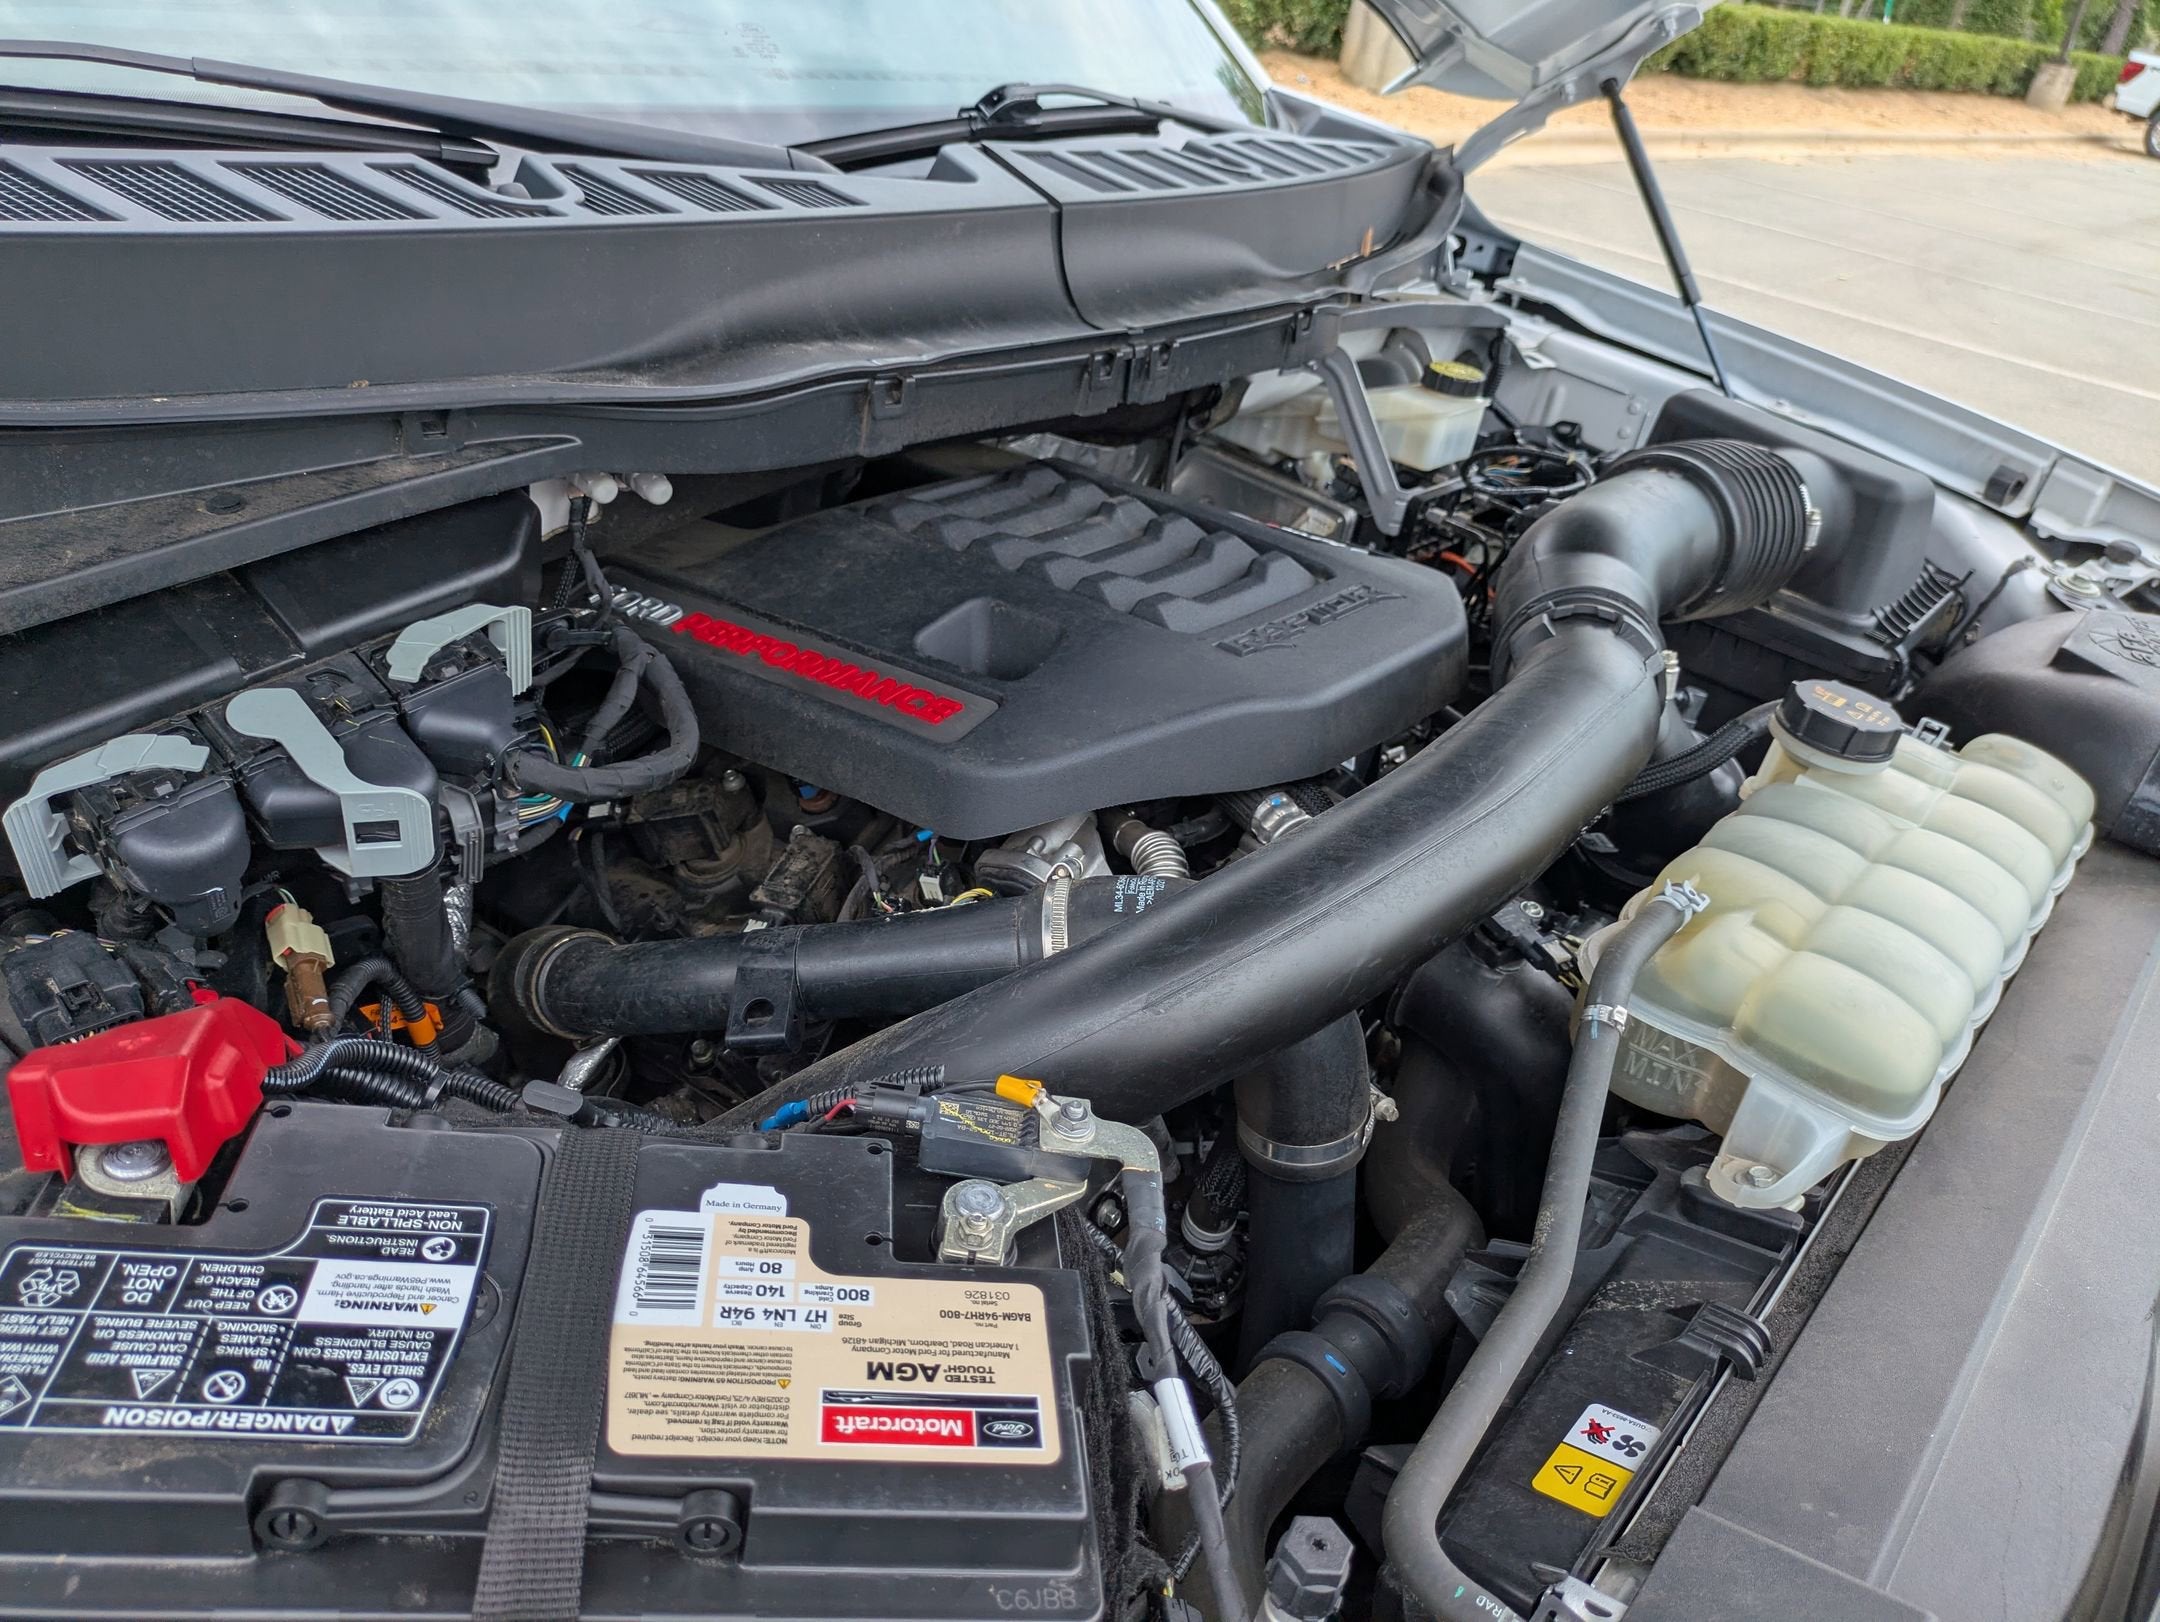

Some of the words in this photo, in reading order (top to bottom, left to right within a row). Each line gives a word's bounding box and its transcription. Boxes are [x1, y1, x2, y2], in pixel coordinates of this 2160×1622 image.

[1212, 583, 1406, 657] RAPTOR
[672, 611, 964, 726] PERFORMANCE
[1635, 1024, 1701, 1067] MAX
[1624, 1051, 1692, 1095] MIN
[349, 1205, 394, 1216] Battery
[743, 1202, 782, 1212] Germany
[397, 1209, 425, 1218] Acid
[427, 1210, 458, 1219] Lead
[336, 1215, 462, 1231] NON-SPILLABLE
[748, 1228, 797, 1236] Recommended
[326, 1234, 418, 1246] INSTRUCTIONS.
[381, 1247, 416, 1256] READ
[122, 1264, 177, 1276] OPEN.
[200, 1263, 265, 1274] CHILDREN.
[759, 1262, 782, 1274] 80
[126, 1278, 164, 1289] NOT
[195, 1275, 213, 1284] OF
[215, 1276, 260, 1286] REACH
[335, 1273, 451, 1284] www.P65Warnings.ca.gov
[331, 1280, 370, 1290] handling.
[371, 1283, 394, 1292] after
[396, 1284, 423, 1293] hands
[209, 1288, 234, 1298] THE
[236, 1289, 255, 1298] OF
[315, 1289, 344, 1298] Harm.
[345, 1291, 405, 1301] Reproductive
[425, 1287, 450, 1295] Wash
[755, 1284, 785, 1298] 140
[837, 1288, 870, 1301] 800
[964, 1290, 1010, 1300] 031826
[122, 1291, 153, 1303] DO
[407, 1294, 425, 1303] and
[427, 1295, 459, 1304] Cancer
[185, 1299, 213, 1308] OUT
[216, 1301, 250, 1310] KEEP
[334, 1300, 419, 1313] WARNING:
[720, 1306, 755, 1320] 94R
[762, 1308, 796, 1322] LN4
[804, 1310, 827, 1322] H7
[939, 1309, 1031, 1321] BAGM-94RH7-800
[37, 1316, 75, 1325] HELP
[94, 1317, 144, 1328] BURNS.
[145, 1319, 198, 1330] SEVERE
[838, 1320, 862, 1328] Group
[38, 1326, 69, 1336] GET
[93, 1329, 116, 1339] OR
[119, 1330, 193, 1341] BLINDNESS
[367, 1328, 413, 1338] INJURY.
[416, 1331, 434, 1339] OR
[314, 1337, 387, 1348] BLINDNESS
[389, 1340, 431, 1349] CAUSE
[868, 1336, 906, 1346] Michigan
[907, 1338, 949, 1347] Dearborn,
[950, 1340, 971, 1348] Road,
[973, 1341, 1014, 1350] American
[111, 1342, 157, 1352] CAUSE
[159, 1343, 188, 1352] CAN
[293, 1347, 321, 1357] CAN
[852, 1345, 890, 1354] Company
[892, 1347, 917, 1355] Motor
[323, 1349, 362, 1359] GASES
[365, 1350, 429, 1361] EXPLOSIVE
[918, 1348, 937, 1357] Ford
[938, 1349, 950, 1357] for
[952, 1348, 1010, 1359] Manufactured
[85, 1352, 120, 1364] ACID
[122, 1353, 183, 1366] SULFURIC
[253, 1359, 271, 1371] NO
[346, 1363, 381, 1374] EYES.
[383, 1364, 424, 1376] SHIELD
[866, 1361, 941, 1382] AGM
[678, 1375, 715, 1383] WARNING:
[727, 1377, 776, 1385] PROPOSITION
[944, 1374, 996, 1384] TESTED
[701, 1409, 736, 1417] warranty
[103, 1406, 329, 1432] DANGER/POISON
[752, 1419, 788, 1428] Warranty
[699, 1426, 741, 1434] protection.
[742, 1427, 776, 1435] warranty
[835, 1415, 963, 1437] Motorcraft
[992, 1422, 1026, 1436] Ford
[632, 1433, 664, 1441] required
[666, 1434, 694, 1442] Receipt
[743, 1436, 762, 1444] Keep
[763, 1437, 787, 1445] NOTE:
[1476, 1595, 1502, 1617] RAD
